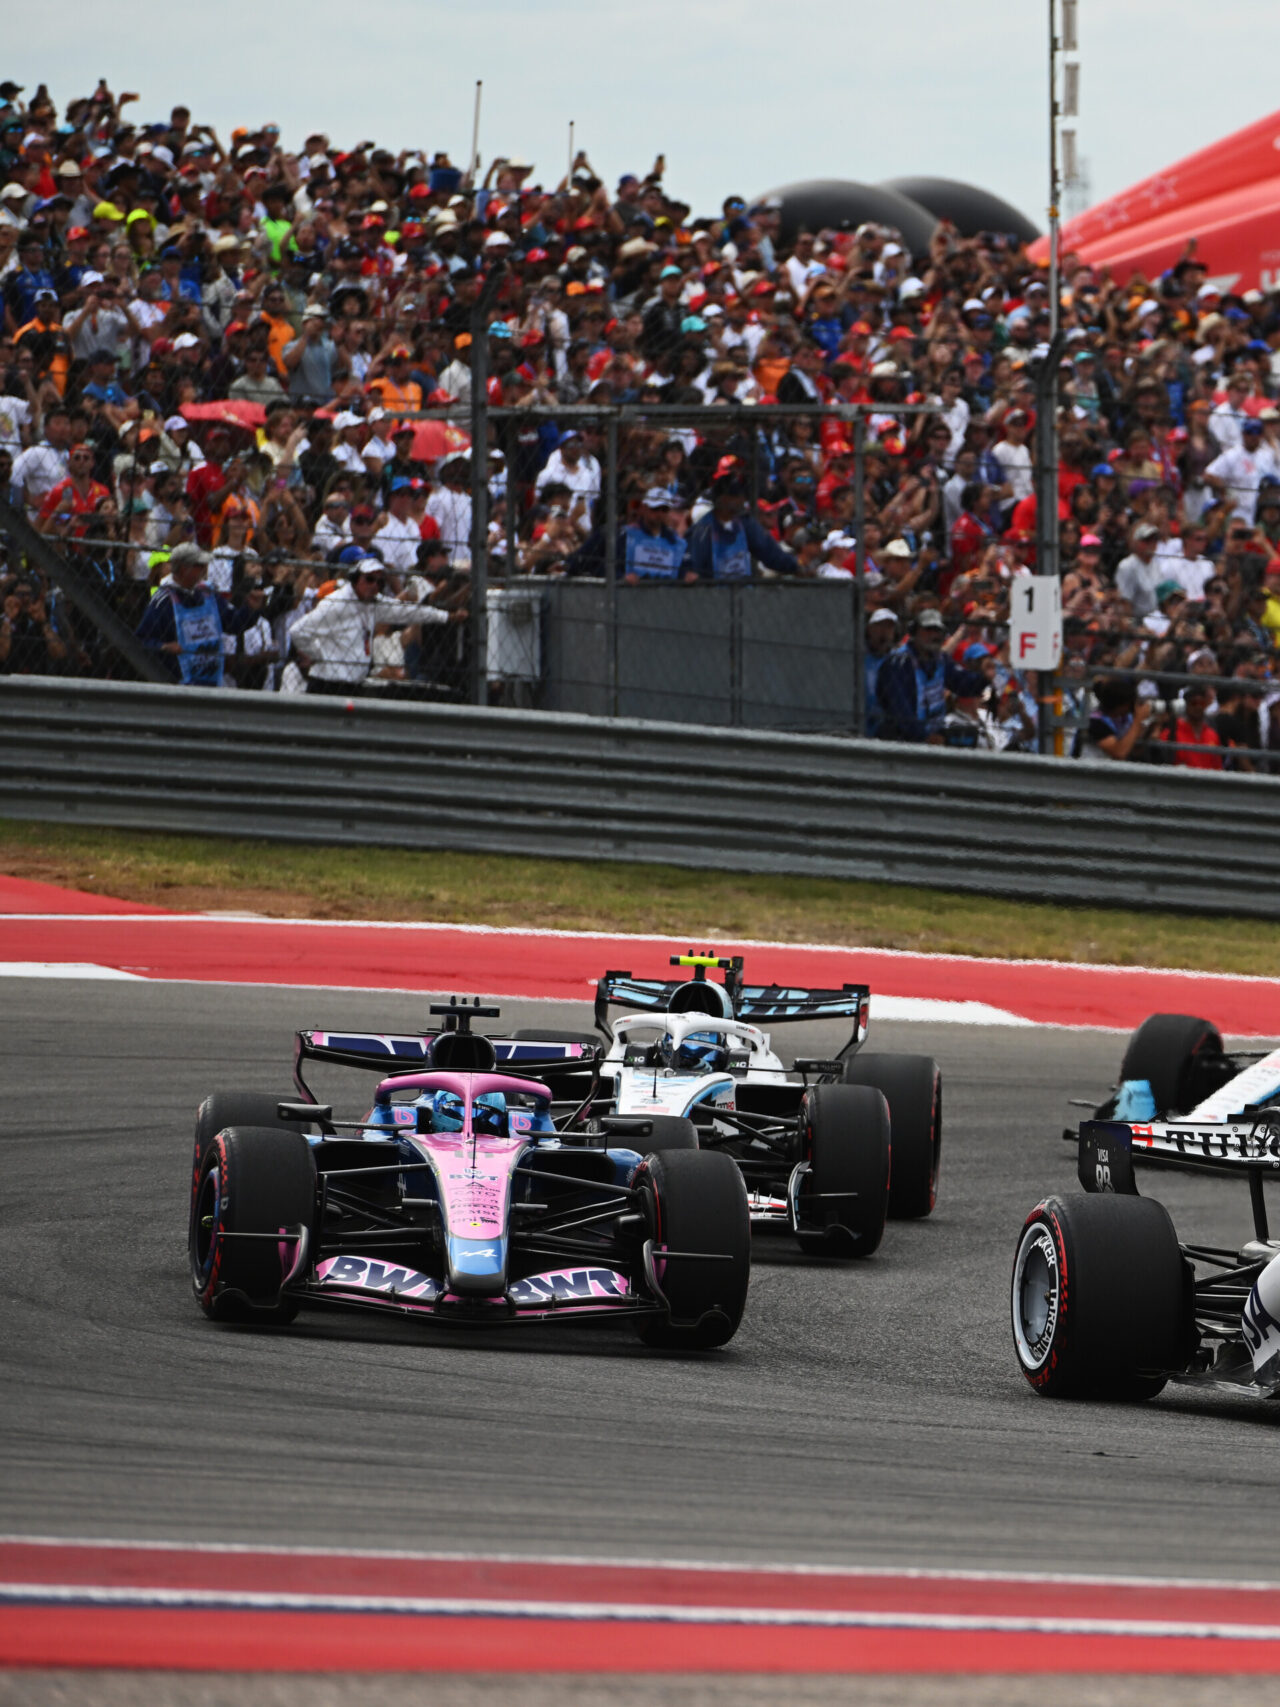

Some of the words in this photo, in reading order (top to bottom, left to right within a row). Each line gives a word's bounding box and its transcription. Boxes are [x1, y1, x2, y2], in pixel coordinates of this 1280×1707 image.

[1023, 586, 1034, 613] 1
[1019, 632, 1037, 658] F
[511, 1270, 623, 1303] BWT
